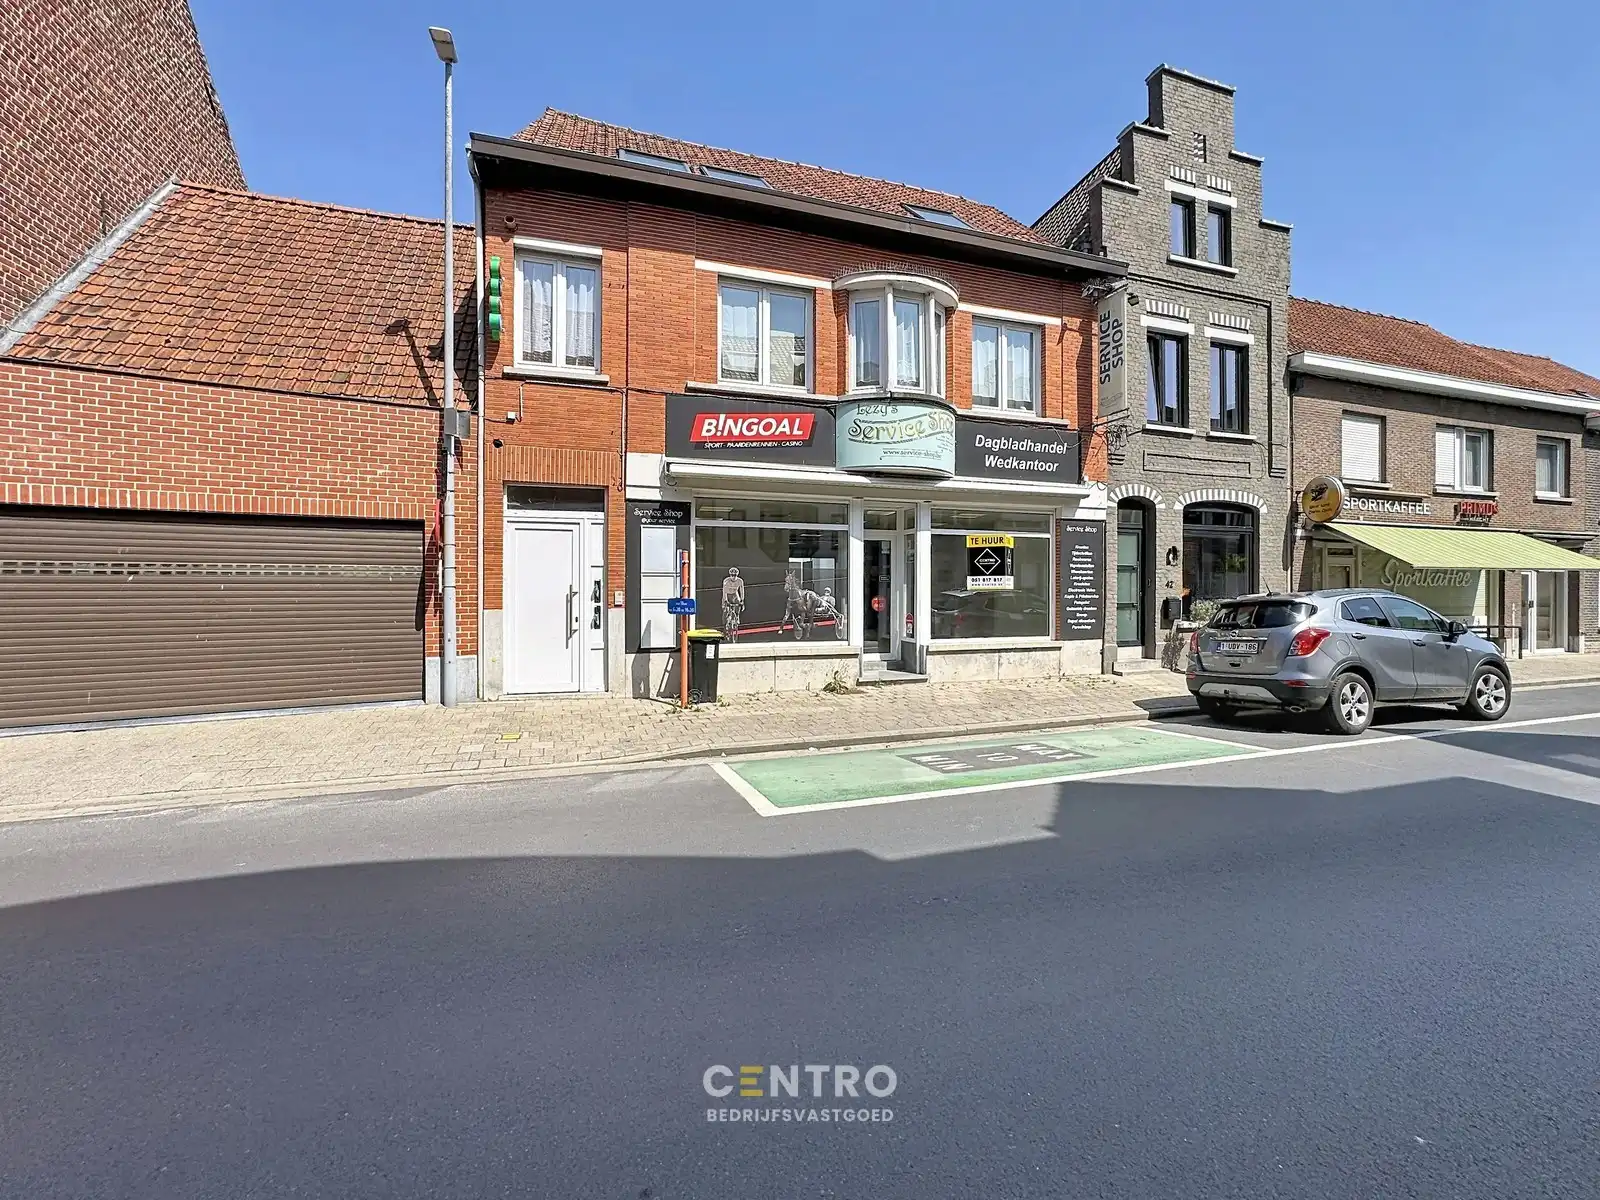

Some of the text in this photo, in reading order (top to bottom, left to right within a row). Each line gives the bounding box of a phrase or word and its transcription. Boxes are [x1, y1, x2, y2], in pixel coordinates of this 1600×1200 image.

[1100, 310, 1111, 385] SERVICE
[1112, 318, 1123, 369] SHOP
[848, 418, 925, 441] Service
[974, 434, 1068, 455] Dagbladhandel
[984, 454, 1059, 472] Wedkantoor
[633, 507, 683, 519] Service Shop
[1342, 496, 1432, 515] SPORTKAFFEE
[1460, 501, 1499, 516] PRIMUS
[970, 536, 1004, 545] TE HUUR
